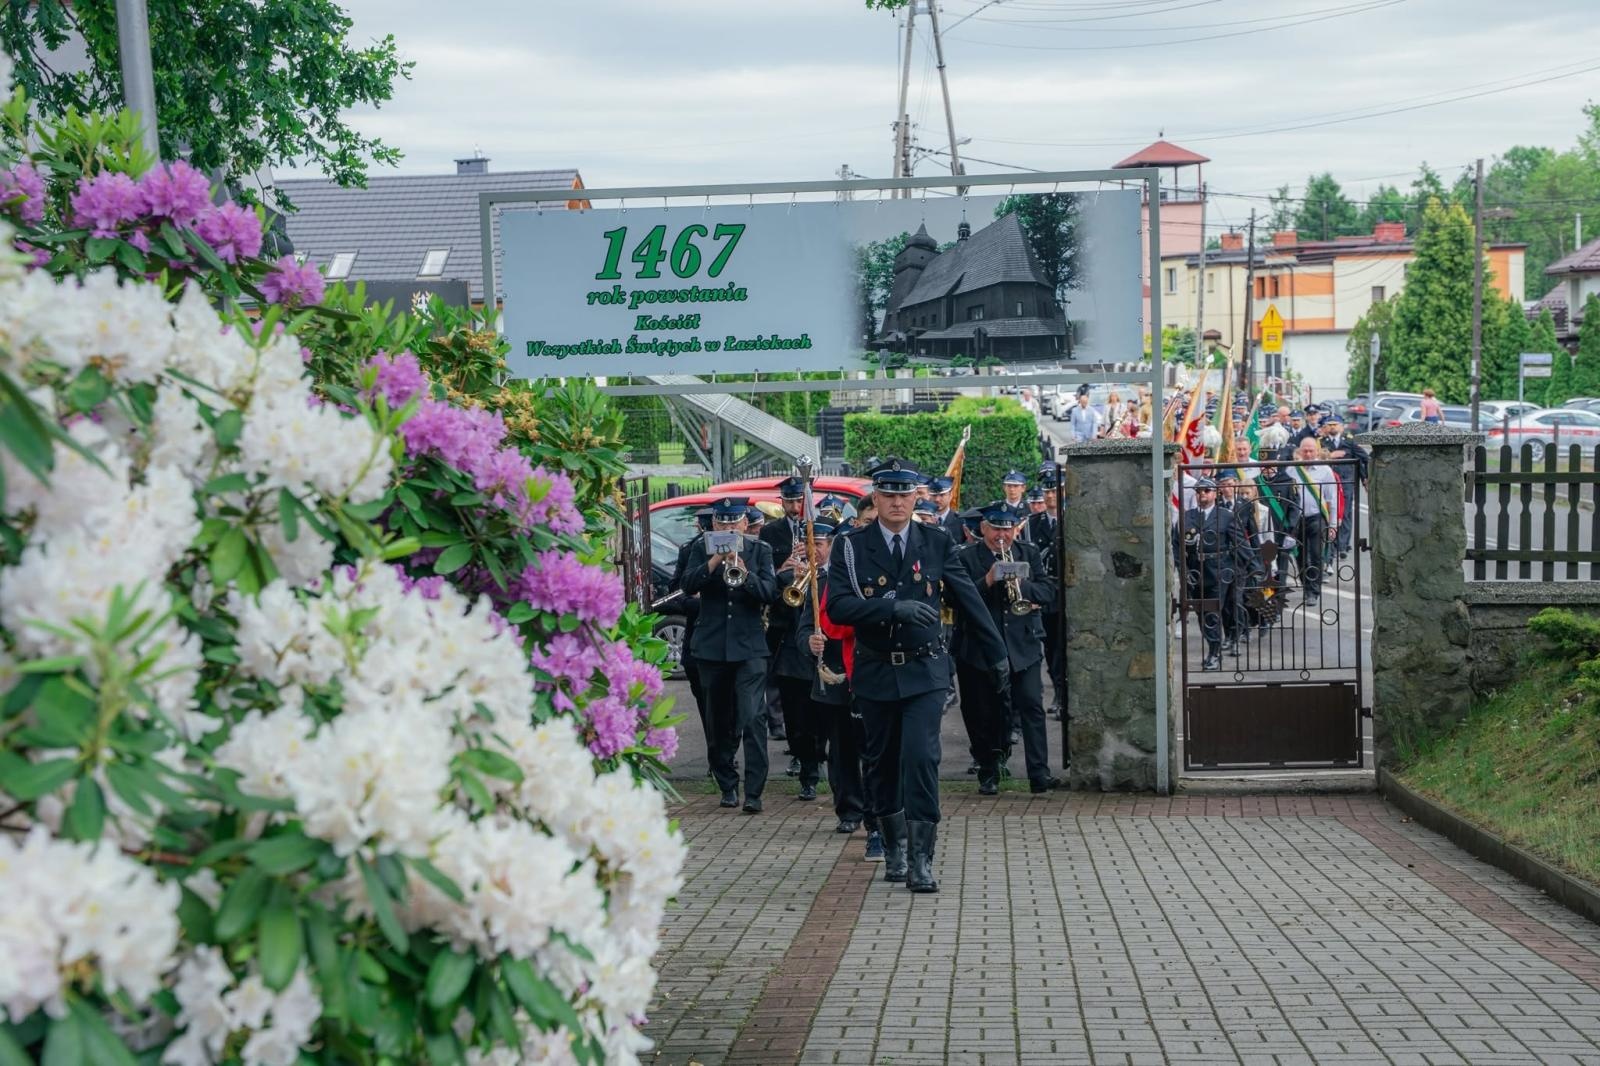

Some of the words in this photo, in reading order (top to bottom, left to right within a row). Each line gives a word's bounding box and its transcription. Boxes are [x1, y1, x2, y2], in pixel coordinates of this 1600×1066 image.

[595, 223, 746, 280] 1467
[586, 285, 627, 305] rok
[628, 282, 748, 309] powstania
[634, 313, 702, 331] Kościół
[526, 339, 622, 360] Wszystkich
[625, 334, 702, 357] Świętych
[704, 340, 721, 352] w
[723, 333, 812, 352] Łaziskach
